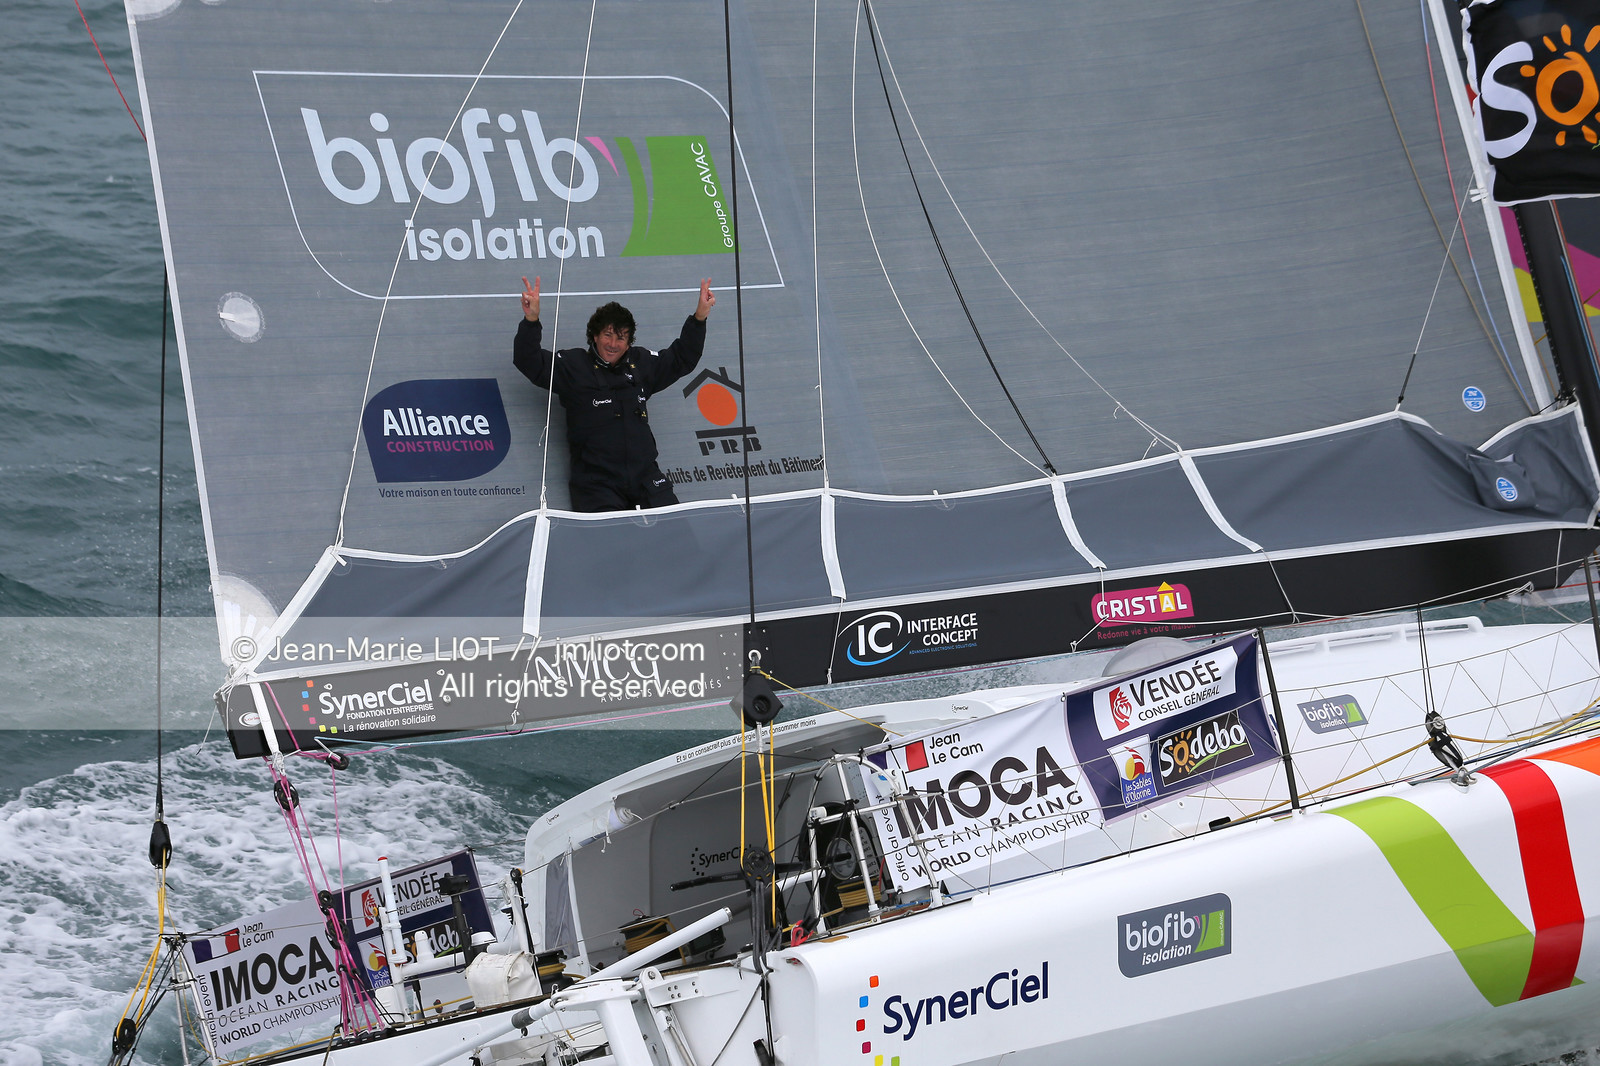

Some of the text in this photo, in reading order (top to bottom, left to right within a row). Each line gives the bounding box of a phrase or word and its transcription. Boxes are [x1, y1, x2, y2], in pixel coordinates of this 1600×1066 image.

[300, 107, 600, 218] biofib
[691, 142, 734, 248] Groupe CAVAC
[404, 218, 606, 261] isolation
[383, 408, 491, 437] Alliance
[386, 439, 495, 453] CONSTRUCTION
[698, 437, 762, 456] PRB
[693, 466, 707, 482] de
[769, 459, 782, 475] du
[379, 488, 403, 498] Votre
[406, 488, 439, 498] maison
[441, 488, 450, 497] en
[453, 487, 478, 497] toute
[479, 485, 521, 496] confiance
[1096, 592, 1188, 620] CRISTAL
[907, 612, 978, 634] INTERFACE
[922, 628, 979, 646] CONCEPT
[1097, 630, 1129, 640] Redonne
[1131, 628, 1142, 636] vie
[1143, 627, 1148, 635] à
[1149, 625, 1169, 633] votre
[857, 621, 893, 656] IC
[318, 678, 433, 718] SynerCiel
[1129, 660, 1222, 707] VENDÉE
[346, 703, 434, 720] FONDATION D'ENTREPRISE
[1138, 685, 1220, 722] CONSEIL GÉNÉRAL
[1303, 702, 1343, 722] biofib
[343, 714, 436, 733] La rénovation solidaire
[1320, 718, 1346, 729] isolation
[676, 755, 682, 763] Et
[720, 739, 731, 750] plus
[800, 719, 816, 728] moins
[929, 732, 961, 750] Jean
[932, 741, 984, 765] Le Cam
[1159, 721, 1248, 778] Sodebo
[893, 746, 1075, 839] IMOCA
[1131, 777, 1152, 791] Sables
[906, 824, 982, 857] OCEAN
[989, 790, 1084, 832] RACING
[912, 851, 972, 878] WORLD
[974, 811, 1091, 858] CHAMPIONSHIP
[242, 930, 274, 948] Le Cam
[243, 921, 263, 935] Jean
[1126, 911, 1196, 951] biofib
[1142, 944, 1192, 966] isolation
[210, 936, 335, 1012] IMOCA
[197, 974, 212, 1007] event
[218, 976, 340, 1028] OCEAN RACING
[883, 960, 1049, 1041] SynerCiel
[220, 994, 341, 1045] WORLD CHAMPIONSHI
